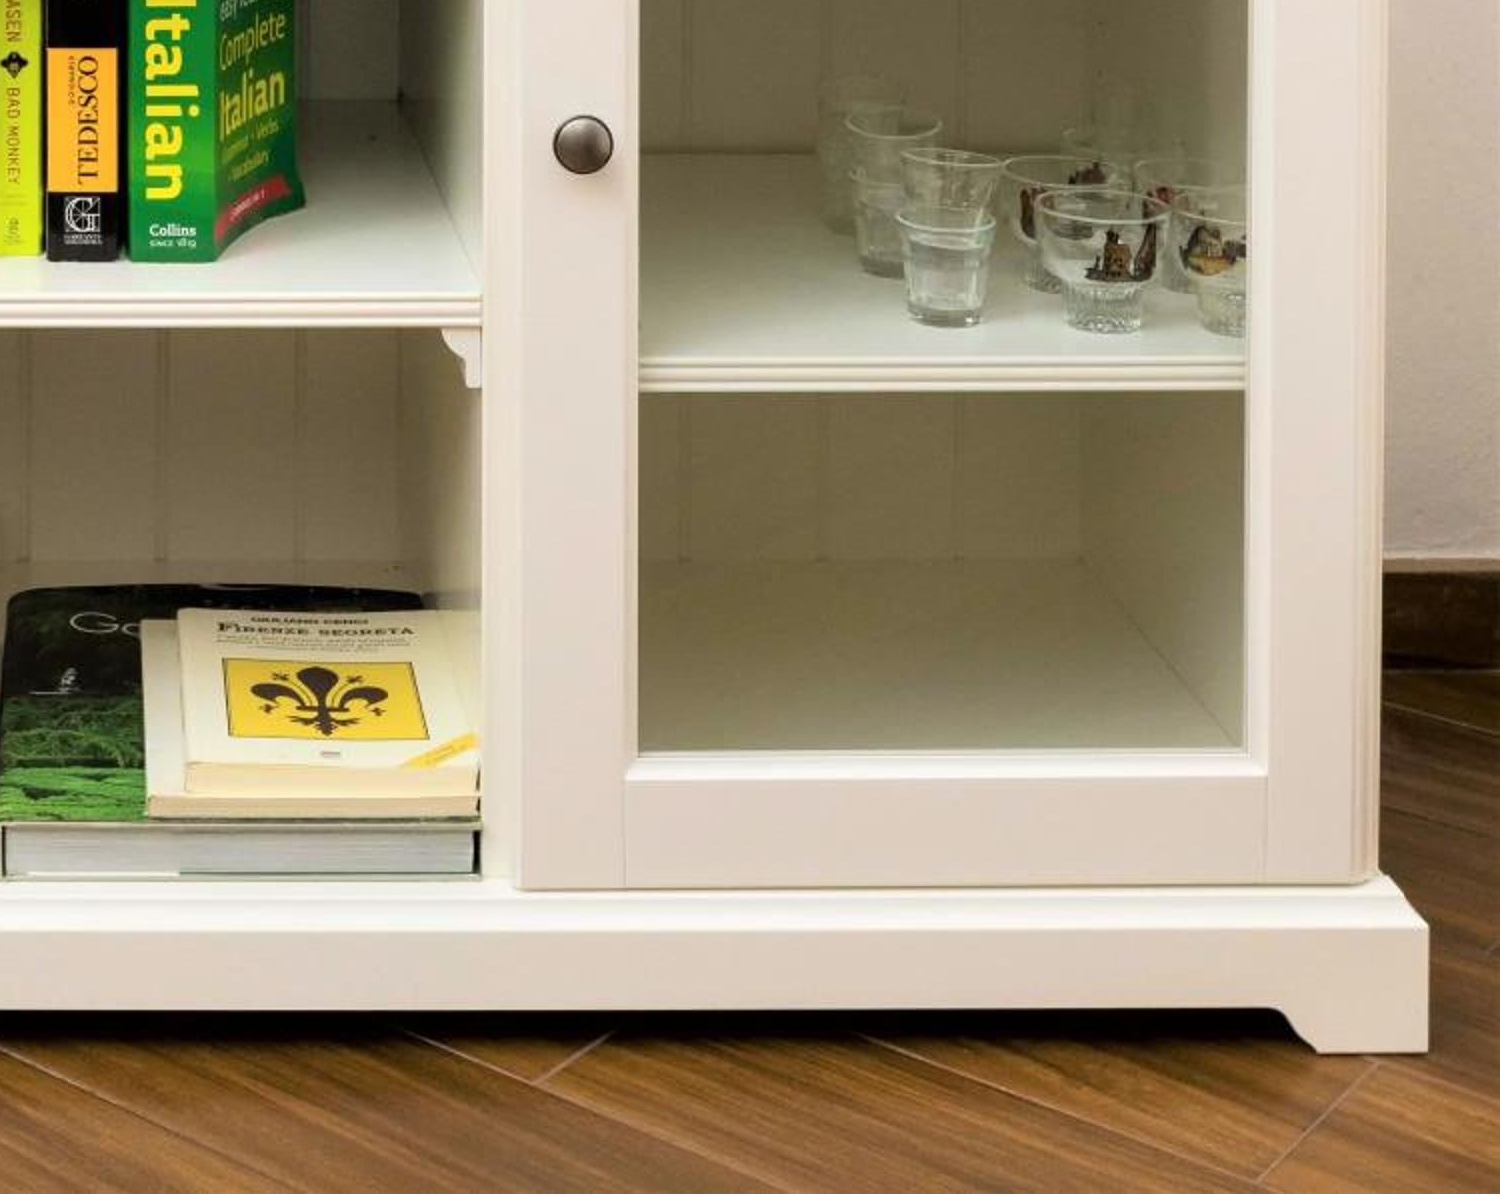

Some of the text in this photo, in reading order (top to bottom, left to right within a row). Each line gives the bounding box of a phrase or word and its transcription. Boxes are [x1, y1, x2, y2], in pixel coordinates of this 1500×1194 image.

[219, 13, 286, 70] Complete
[10, 87, 20, 118] BAD
[77, 55, 100, 185] TEDESCO
[219, 69, 285, 142] Italian
[10, 126, 20, 185] MONKEY
[149, 223, 197, 237] Collins
